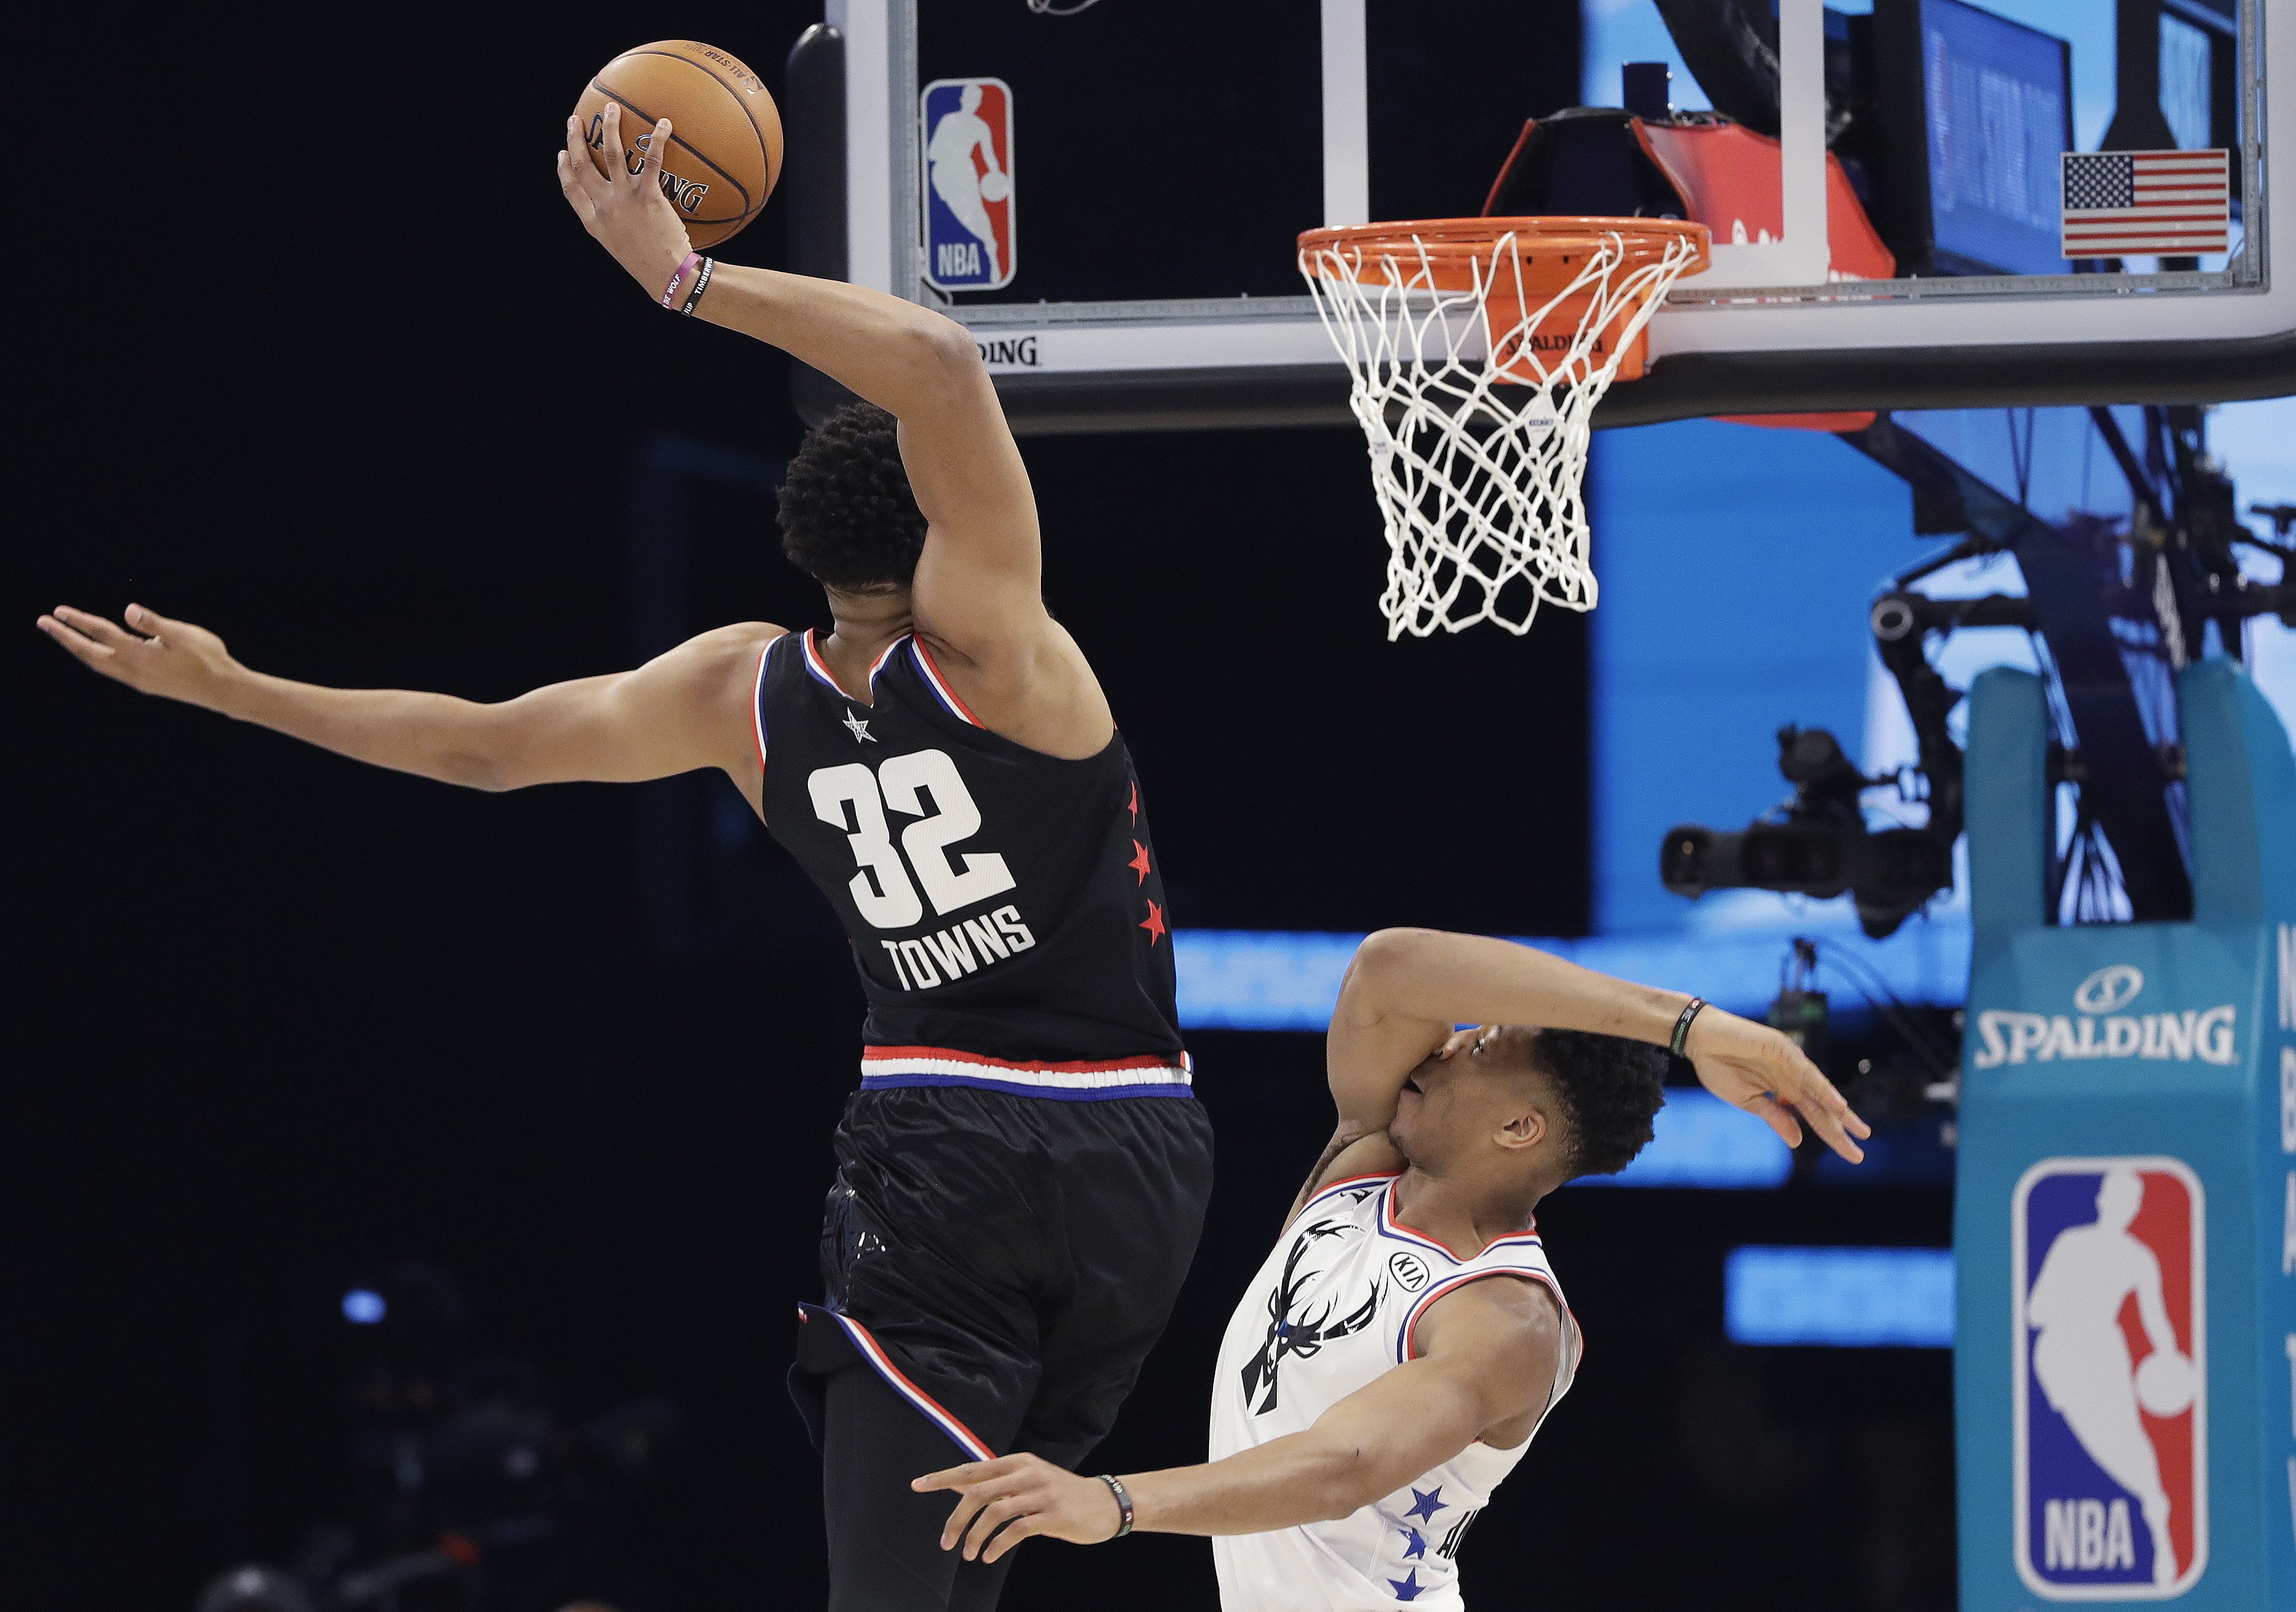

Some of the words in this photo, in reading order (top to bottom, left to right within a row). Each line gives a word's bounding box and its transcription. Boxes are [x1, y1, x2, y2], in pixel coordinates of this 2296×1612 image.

[667, 273, 681, 294] WOLF
[938, 242, 982, 277] NBA
[807, 748, 1017, 929] 32
[880, 904, 1036, 991] TOWNS
[1974, 1004, 2237, 1069] SPALDING
[1394, 1255, 1424, 1290] KIA
[2044, 1498, 2136, 1571] NBA
